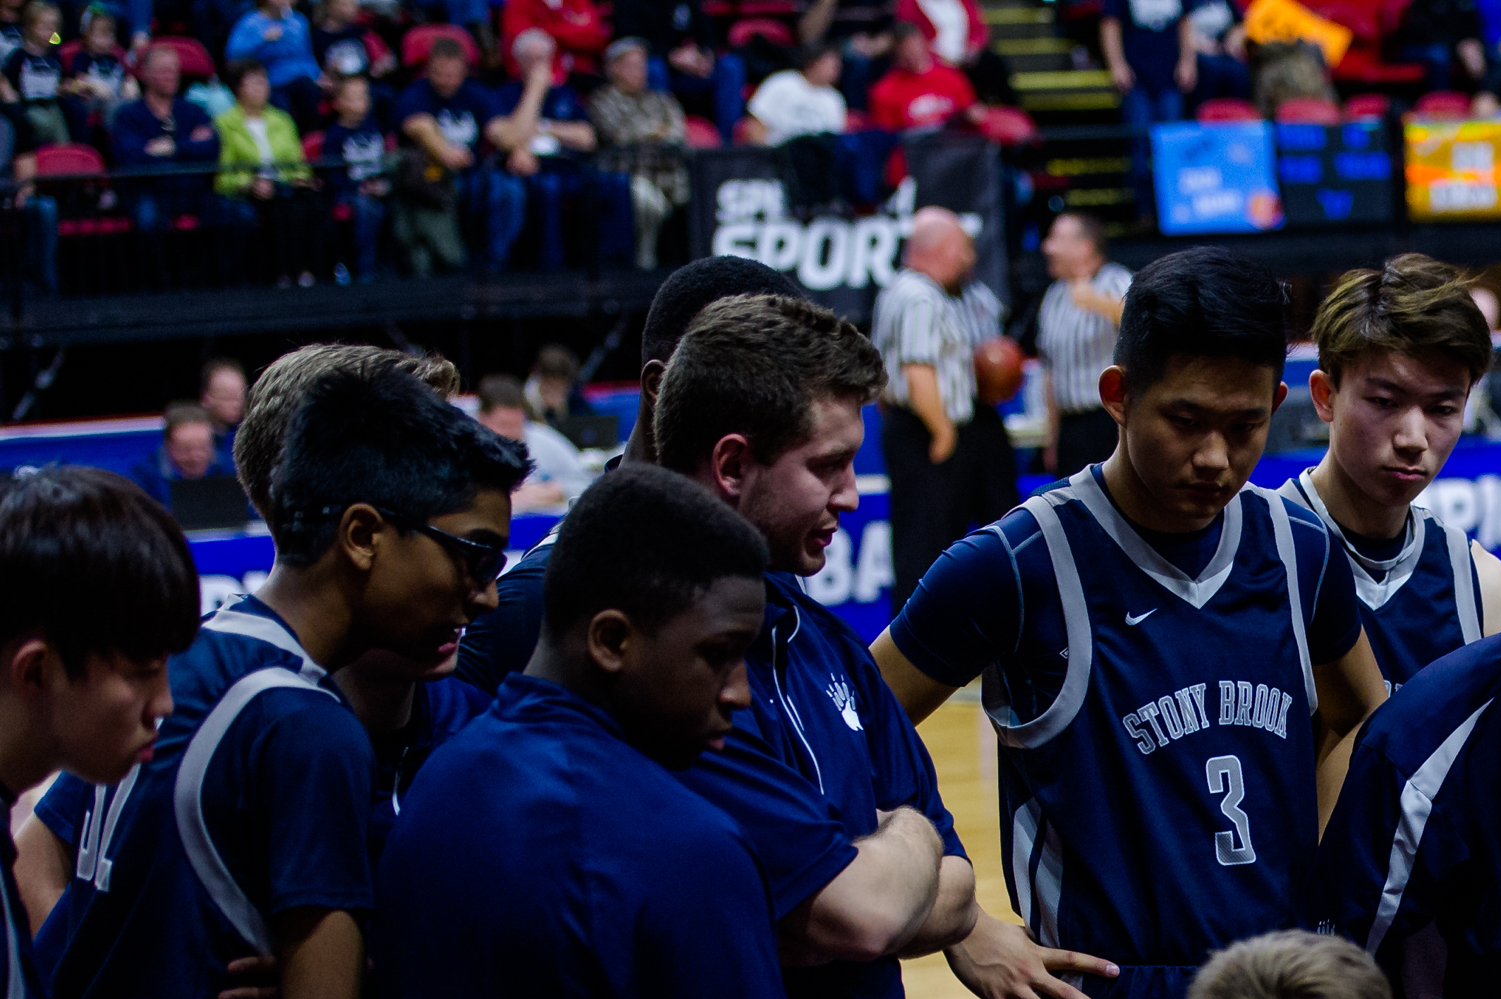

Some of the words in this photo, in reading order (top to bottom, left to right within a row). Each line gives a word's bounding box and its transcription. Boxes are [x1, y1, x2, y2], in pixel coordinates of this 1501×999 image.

[1123, 682, 1210, 755] STONY
[1218, 680, 1293, 740] BROOK
[1206, 754, 1257, 866] 3
